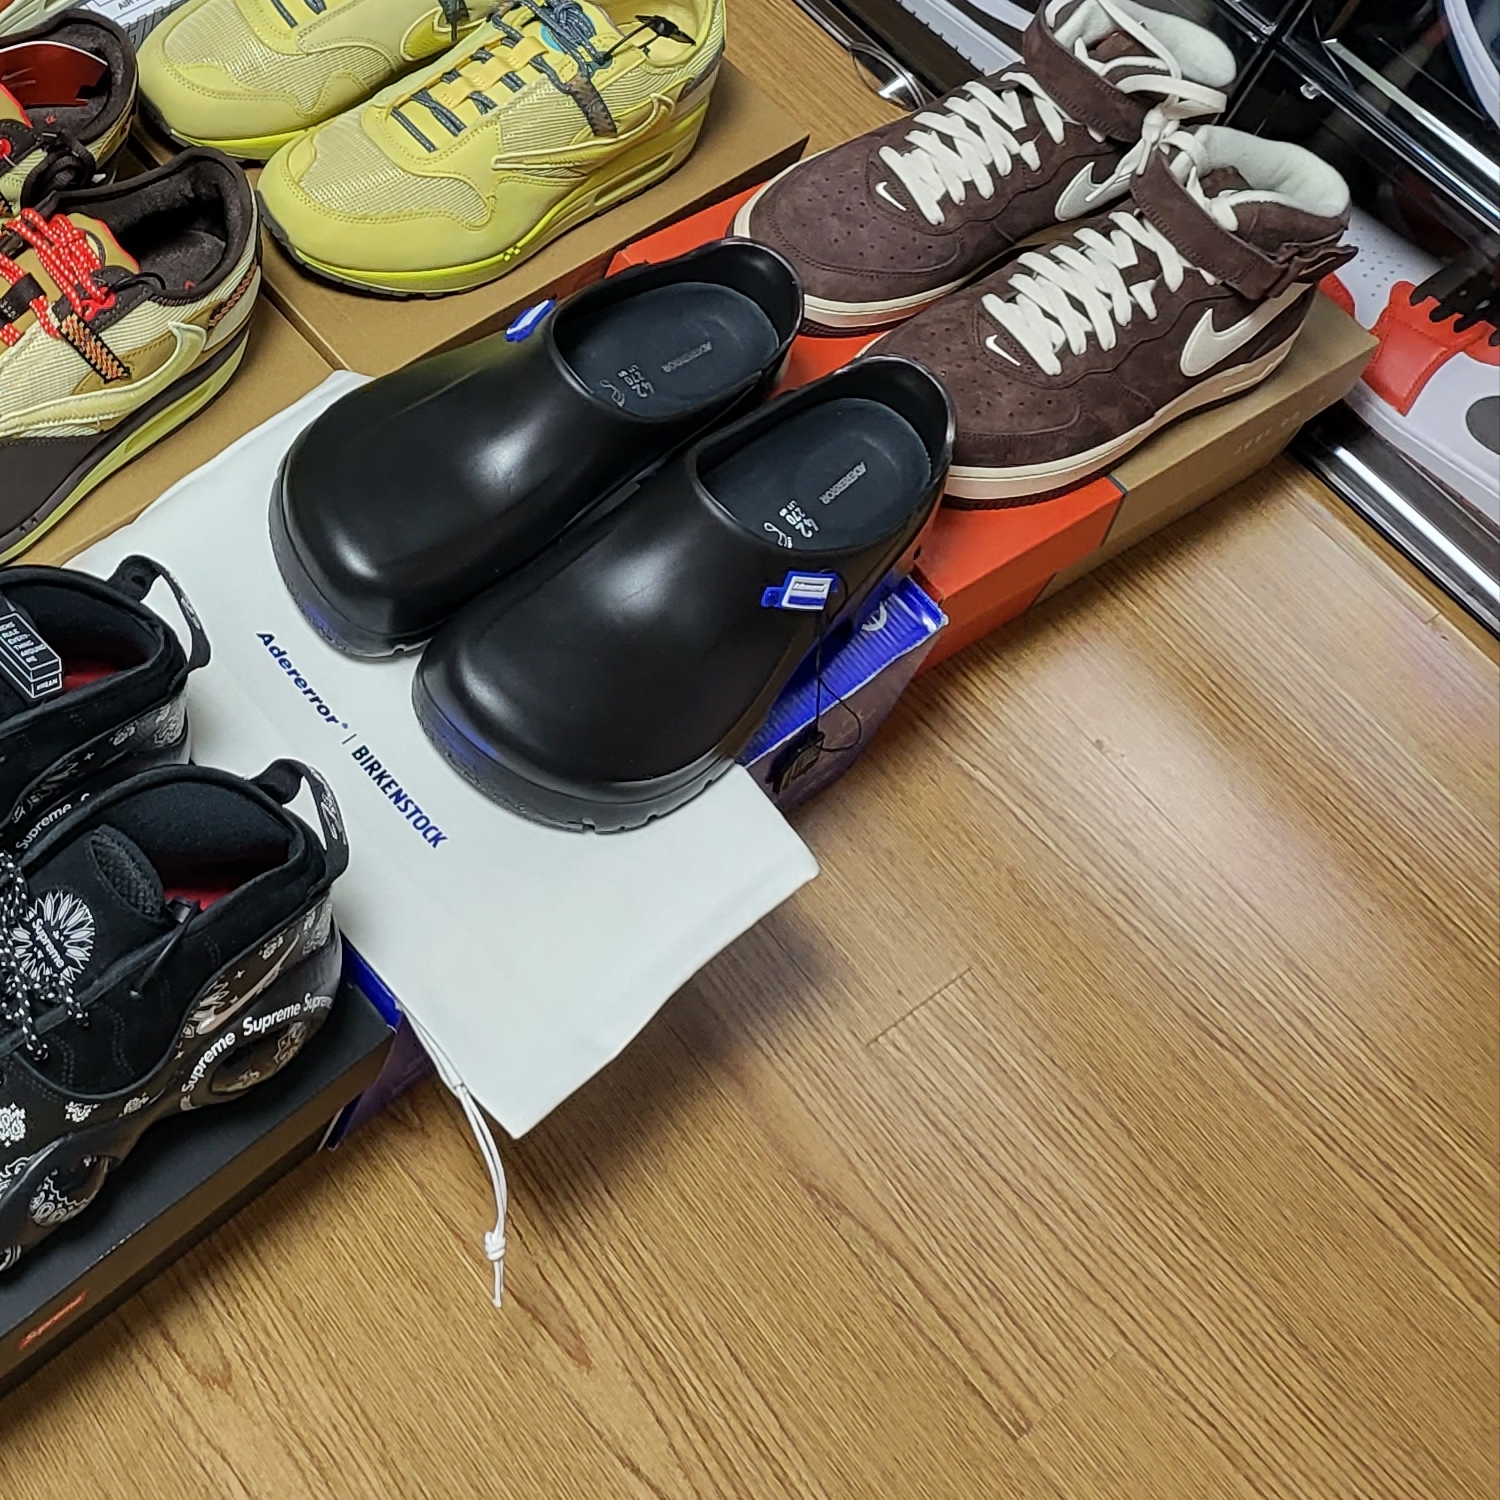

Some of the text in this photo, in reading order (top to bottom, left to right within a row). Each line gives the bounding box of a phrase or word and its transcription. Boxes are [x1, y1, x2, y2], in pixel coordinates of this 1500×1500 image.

[624, 371, 644, 386] 270
[632, 381, 654, 398] 42
[785, 507, 806, 525] 270
[795, 517, 819, 538] 42
[256, 632, 448, 849] Adererror BIRKENSTOCK
[15, 803, 72, 850] Supreme
[32, 918, 65, 968] Supreme
[182, 1031, 236, 1093] Supreme
[242, 1002, 300, 1037] Supreme
